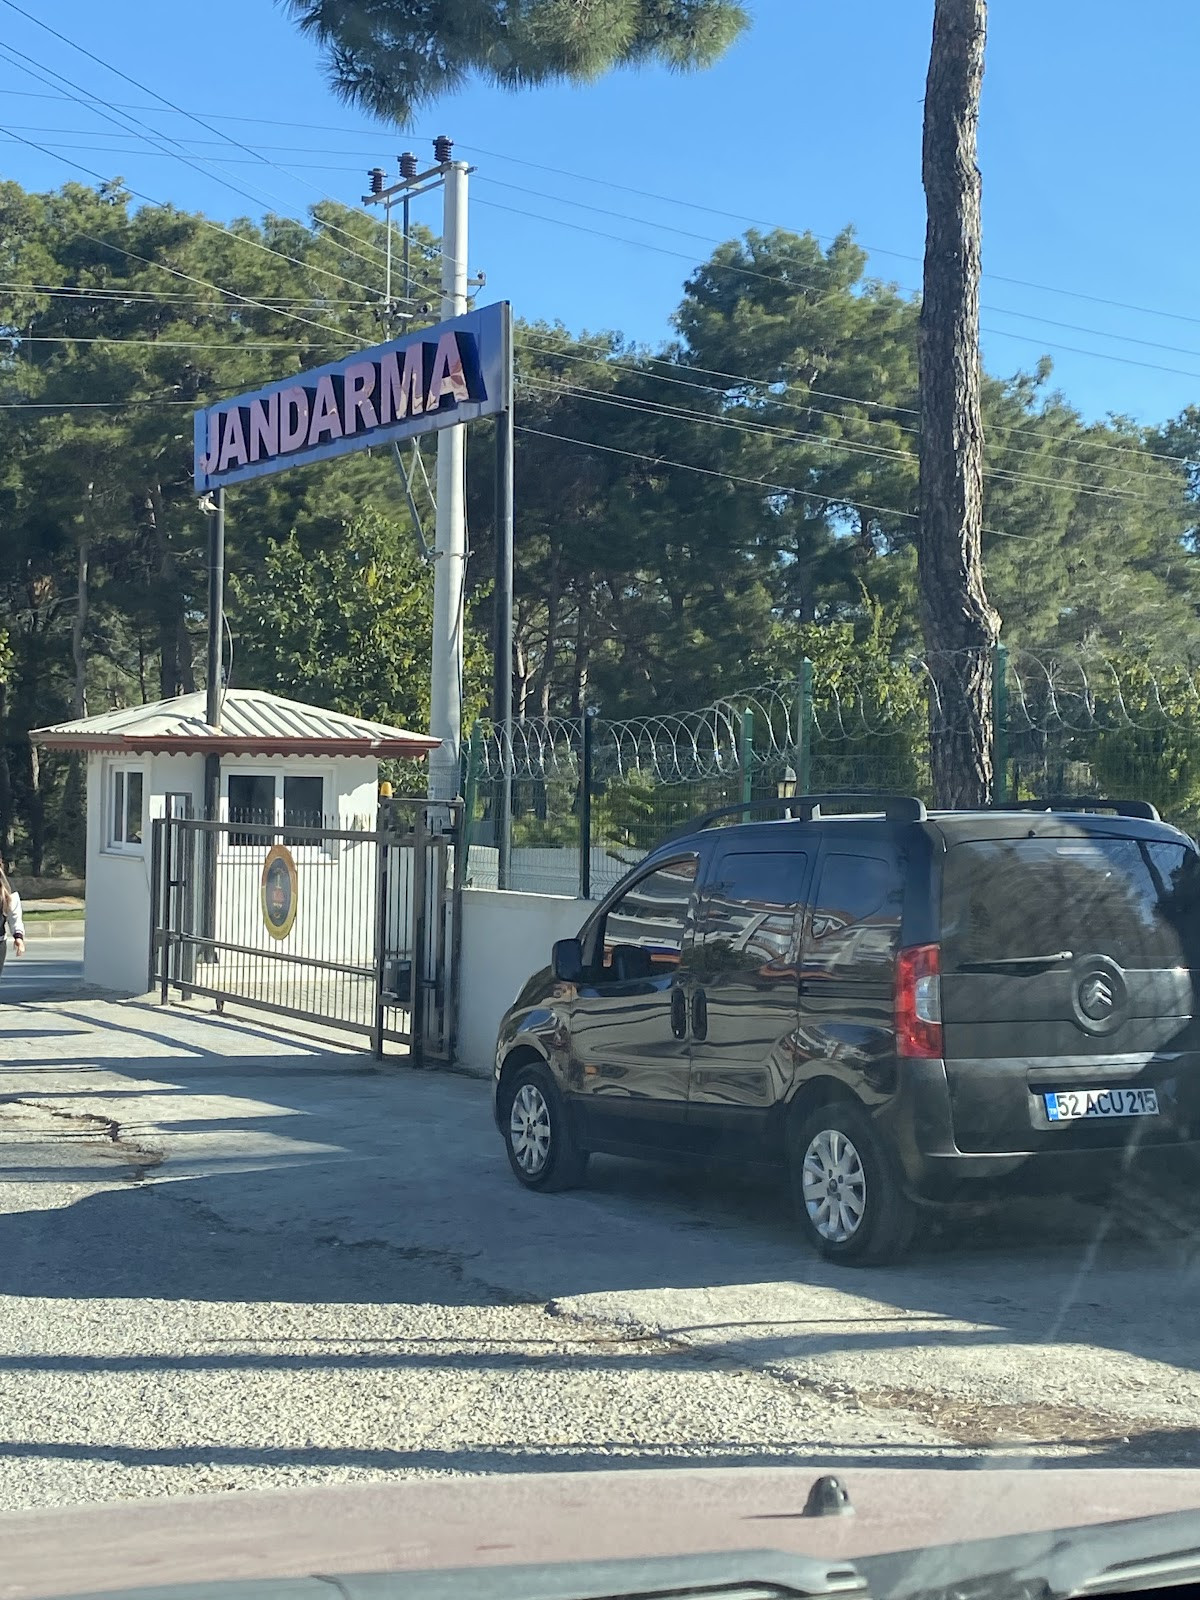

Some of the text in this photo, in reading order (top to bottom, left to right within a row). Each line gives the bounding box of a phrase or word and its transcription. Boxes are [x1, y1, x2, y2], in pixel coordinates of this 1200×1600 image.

[200, 331, 471, 475] JANDARMA
[1056, 1090, 1157, 1116] 52 ACU 215
